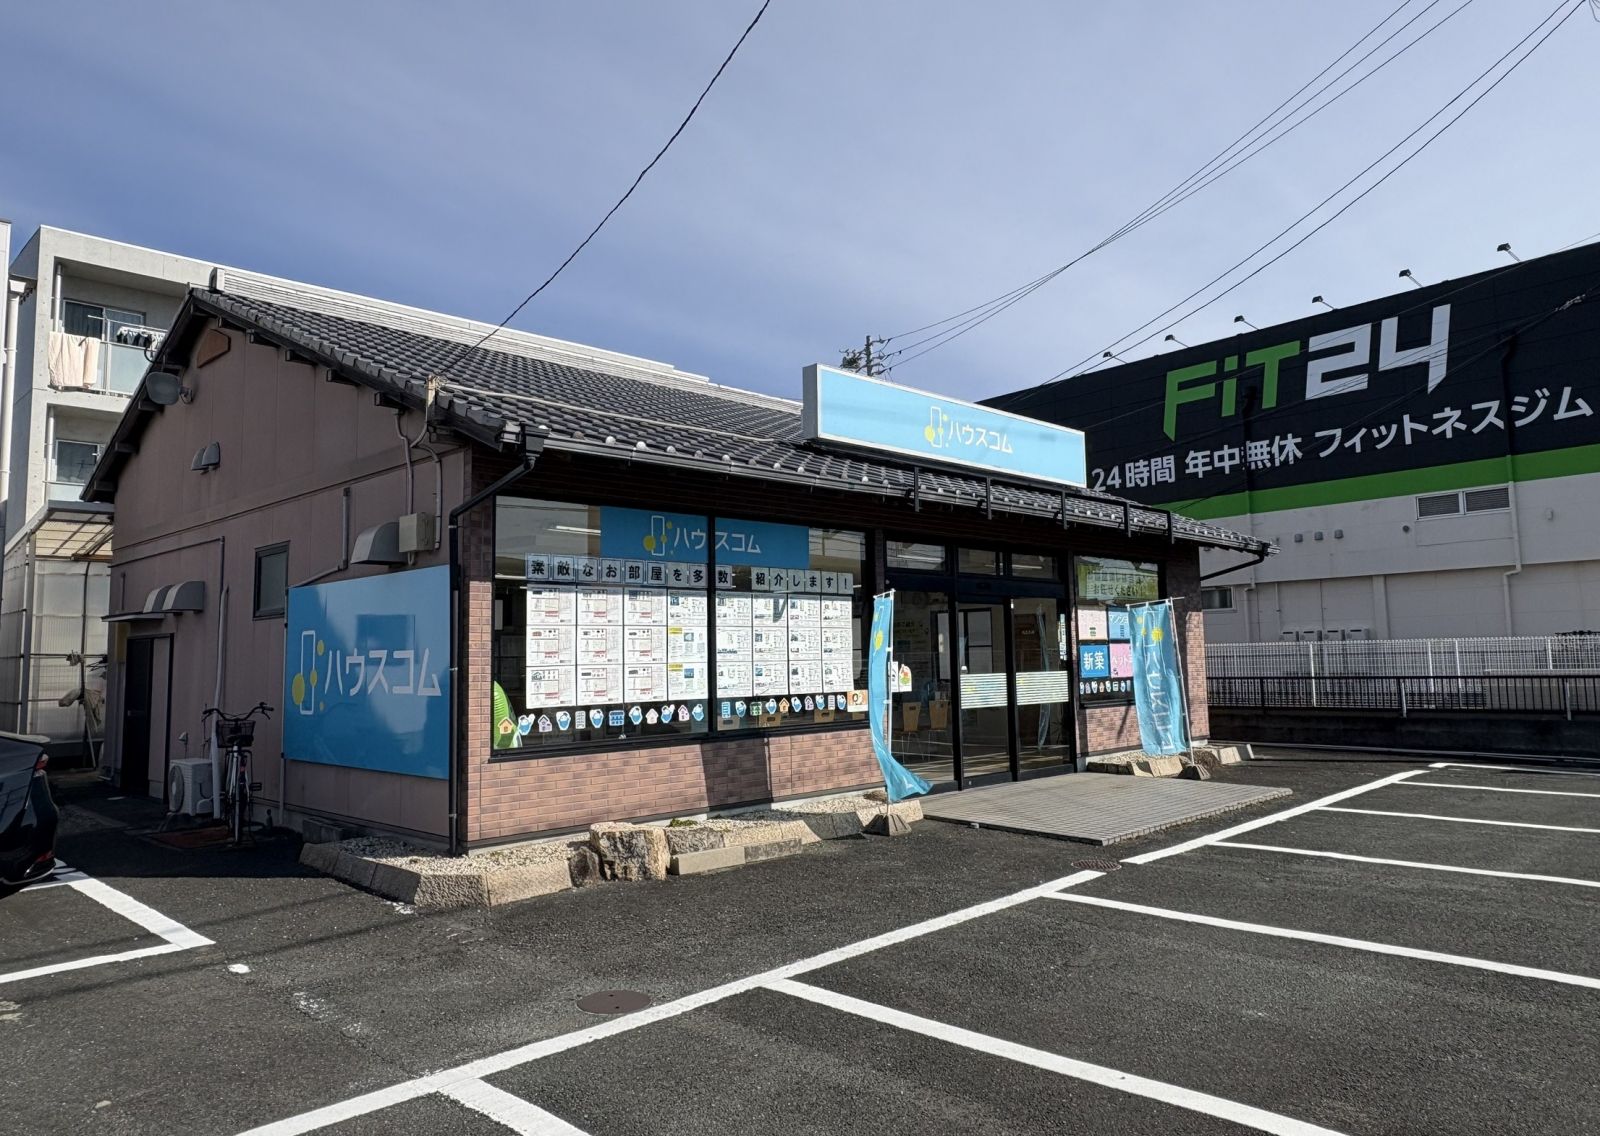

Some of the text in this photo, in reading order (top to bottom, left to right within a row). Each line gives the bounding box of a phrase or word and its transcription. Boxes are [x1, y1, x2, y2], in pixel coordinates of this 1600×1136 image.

[948, 420, 1013, 454] ハウスコム
[1091, 385, 1595, 493] 24時間 年中無休 フィットネスジム
[673, 527, 762, 555] ハウスコム
[530, 559, 730, 585] 素敵なお部屋を多数
[324, 647, 442, 697] ハウスコム
[1083, 650, 1105, 671] 新築
